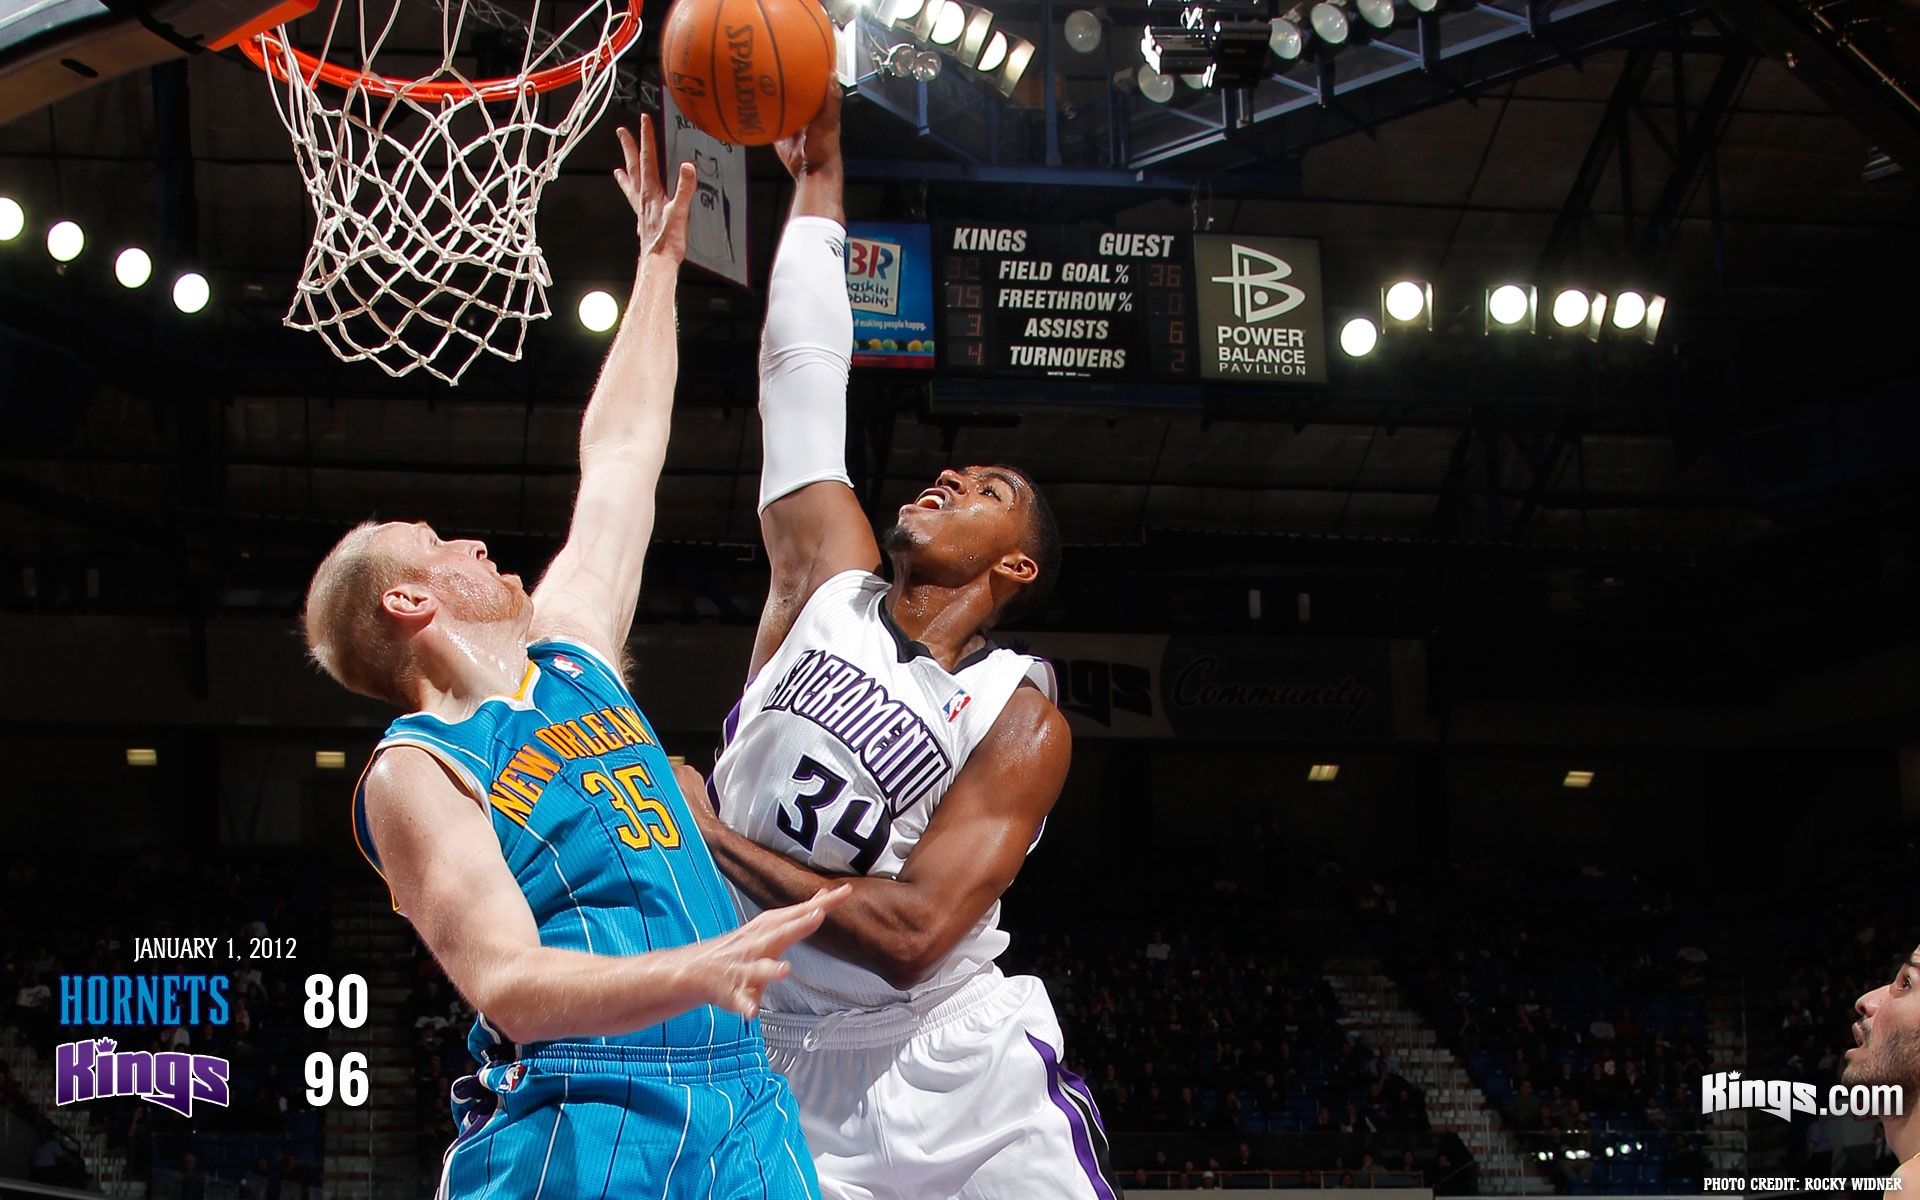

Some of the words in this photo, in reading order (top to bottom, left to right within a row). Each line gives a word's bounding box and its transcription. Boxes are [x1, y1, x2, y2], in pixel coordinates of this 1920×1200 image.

[724, 23, 766, 136] SPALDING
[953, 227, 1027, 252] KINGS
[1099, 232, 1175, 257] GUEST
[998, 260, 1053, 281] FIELD
[1061, 262, 1111, 283] GOAL
[1148, 264, 1181, 287] 36
[966, 313, 982, 337] 3
[1023, 317, 1109, 340] ASSISTS
[1169, 321, 1184, 344] 6
[1217, 326, 1304, 347] POWER
[967, 342, 983, 366] 4
[1010, 345, 1126, 369] TURNOVERS
[1170, 349, 1185, 372] 2
[1218, 346, 1306, 364] BALANCE
[1219, 363, 1306, 375] PAVILION
[1174, 655, 1376, 728] Community
[761, 649, 952, 820] SACRAMENTO
[489, 744, 561, 827] NEW
[534, 705, 657, 760] ORLEAN
[581, 763, 681, 850] 35
[777, 754, 891, 876] 34
